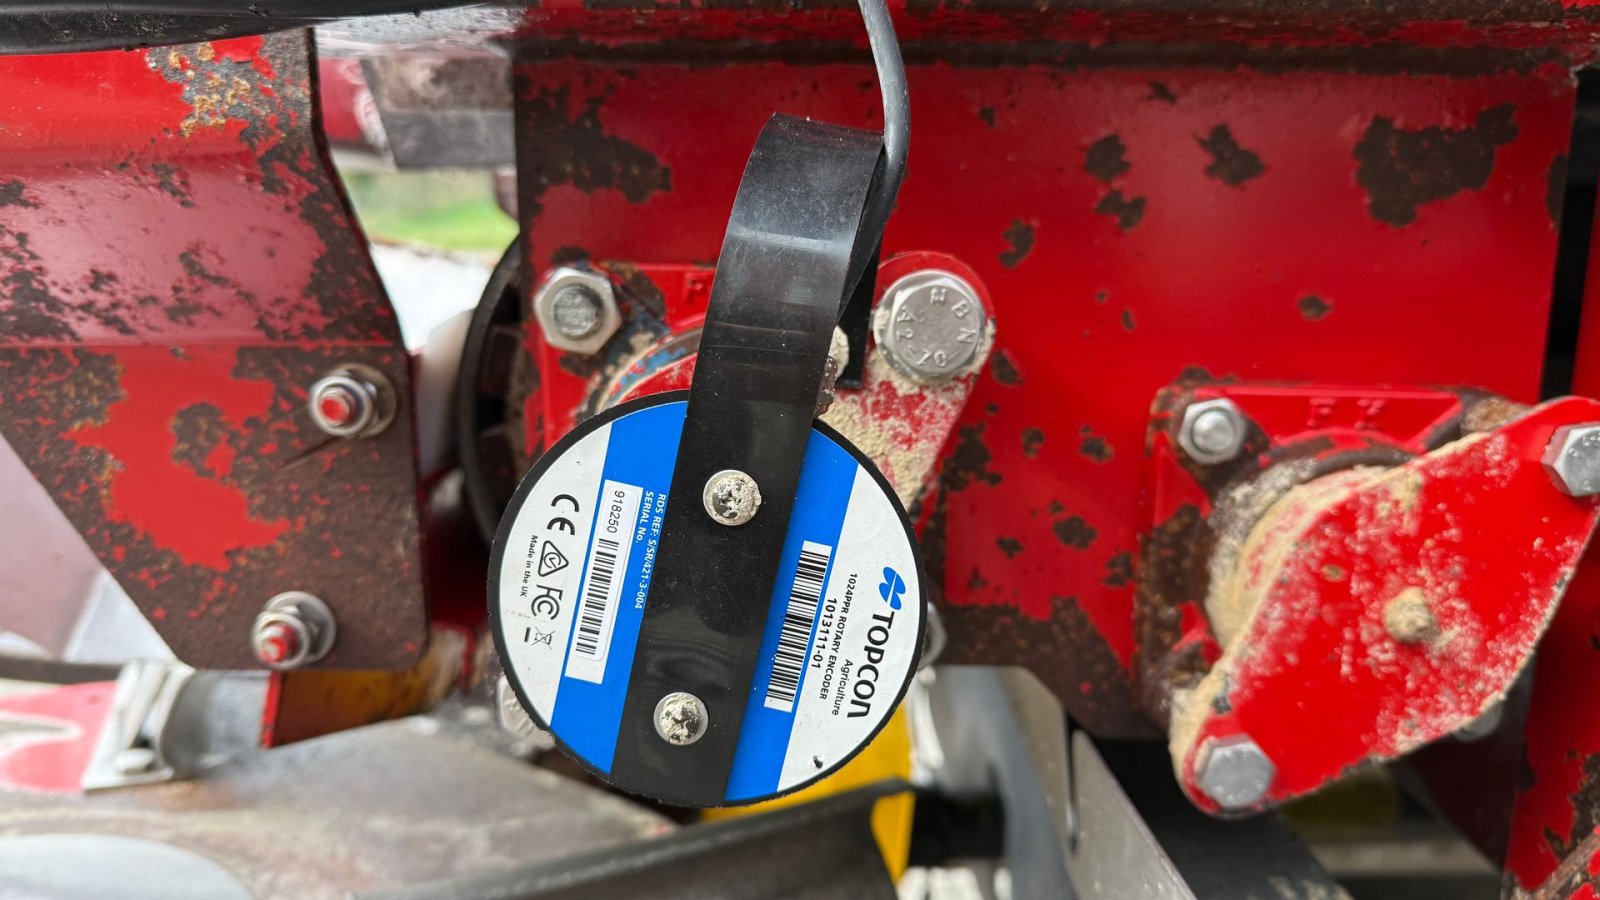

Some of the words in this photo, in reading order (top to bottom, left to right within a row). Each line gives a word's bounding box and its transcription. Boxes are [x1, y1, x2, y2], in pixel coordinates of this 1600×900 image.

[606, 490, 625, 534] 918250
[640, 490, 654, 524] SERIAL
[655, 493, 667, 514] RDS
[635, 527, 647, 544] No.
[650, 516, 661, 536] REF:
[525, 560, 534, 569] in
[527, 534, 538, 559] Made
[519, 586, 529, 598] UK
[522, 570, 531, 584] the
[634, 539, 656, 609] S/SR/421-3-004
[841, 572, 858, 614] 1024PPR
[811, 598, 838, 669] 1013111-01
[832, 616, 847, 654] ROTARY
[819, 655, 837, 700] ENCODER
[846, 611, 895, 719] TOPCON
[831, 658, 854, 716] Agriculture
